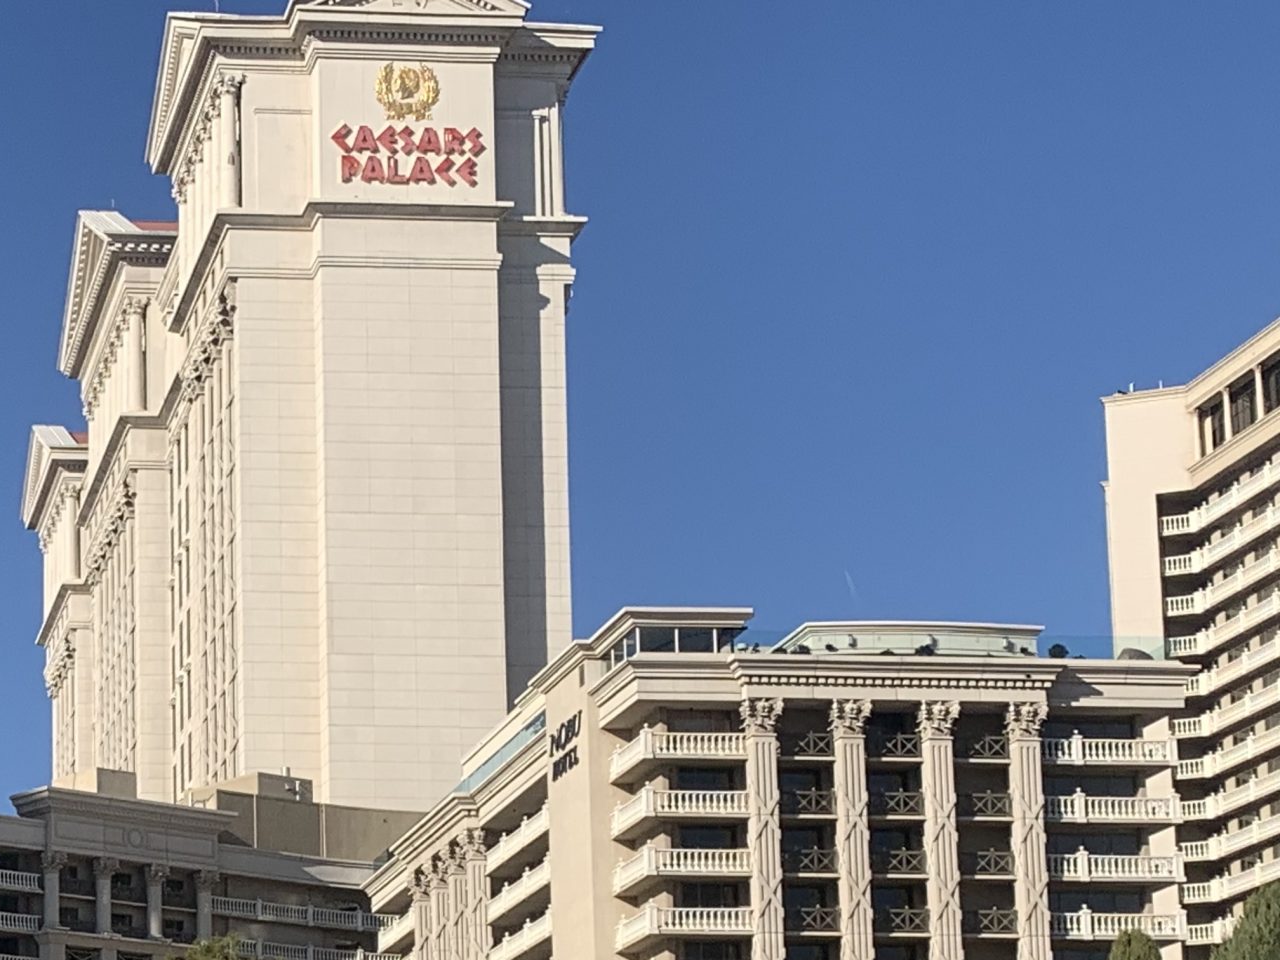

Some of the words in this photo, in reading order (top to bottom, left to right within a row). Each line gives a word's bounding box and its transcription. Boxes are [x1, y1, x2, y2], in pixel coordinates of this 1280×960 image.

[331, 123, 487, 158] CAESARS
[341, 155, 479, 188] PALACE
[549, 709, 582, 757] NOBU
